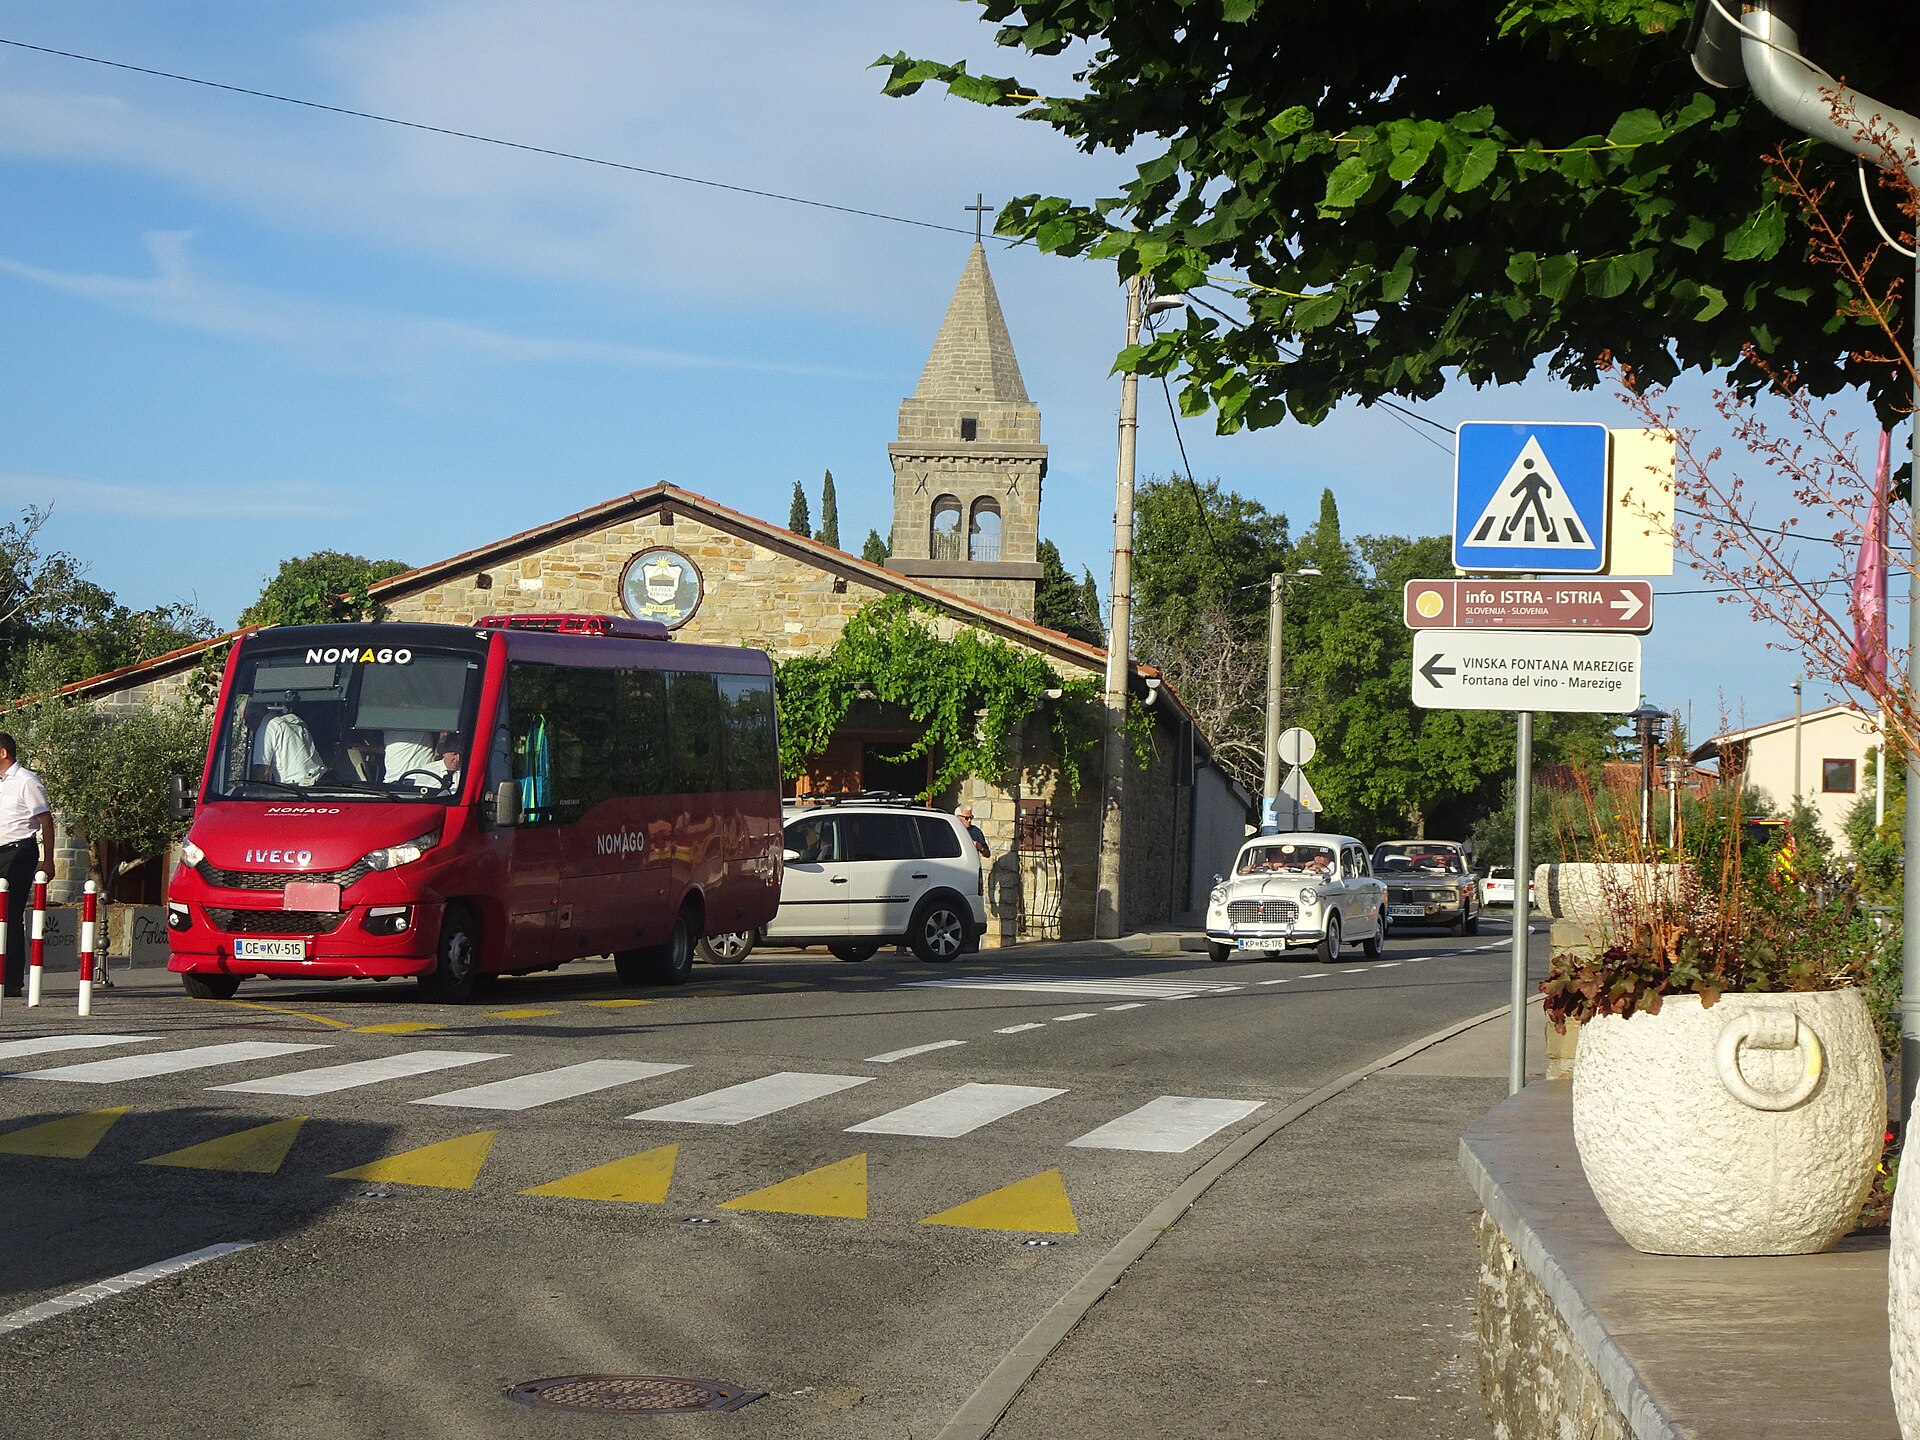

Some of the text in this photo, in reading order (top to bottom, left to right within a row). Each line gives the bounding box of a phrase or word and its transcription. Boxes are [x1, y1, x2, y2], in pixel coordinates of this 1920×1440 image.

[1465, 590, 1495, 604] info
[1500, 590, 1544, 604] ISTRA
[1555, 591, 1604, 604] ISTRIA
[1465, 607, 1506, 615] SLOVENIJA
[1511, 607, 1549, 615] SLOVENIA
[305, 647, 412, 664] NOMAGO
[1462, 657, 1634, 673] VINSKA FONTANA MAREZIGE
[1462, 674, 1508, 686] Fontana
[1512, 675, 1530, 687] del
[1533, 676, 1558, 688] vino
[1568, 677, 1622, 691] Marezige
[597, 832, 644, 855] NOMAGO
[245, 849, 312, 864] IVECO
[245, 942, 301, 955] CE KV-515
[1245, 939, 1283, 948] KP KS-176
